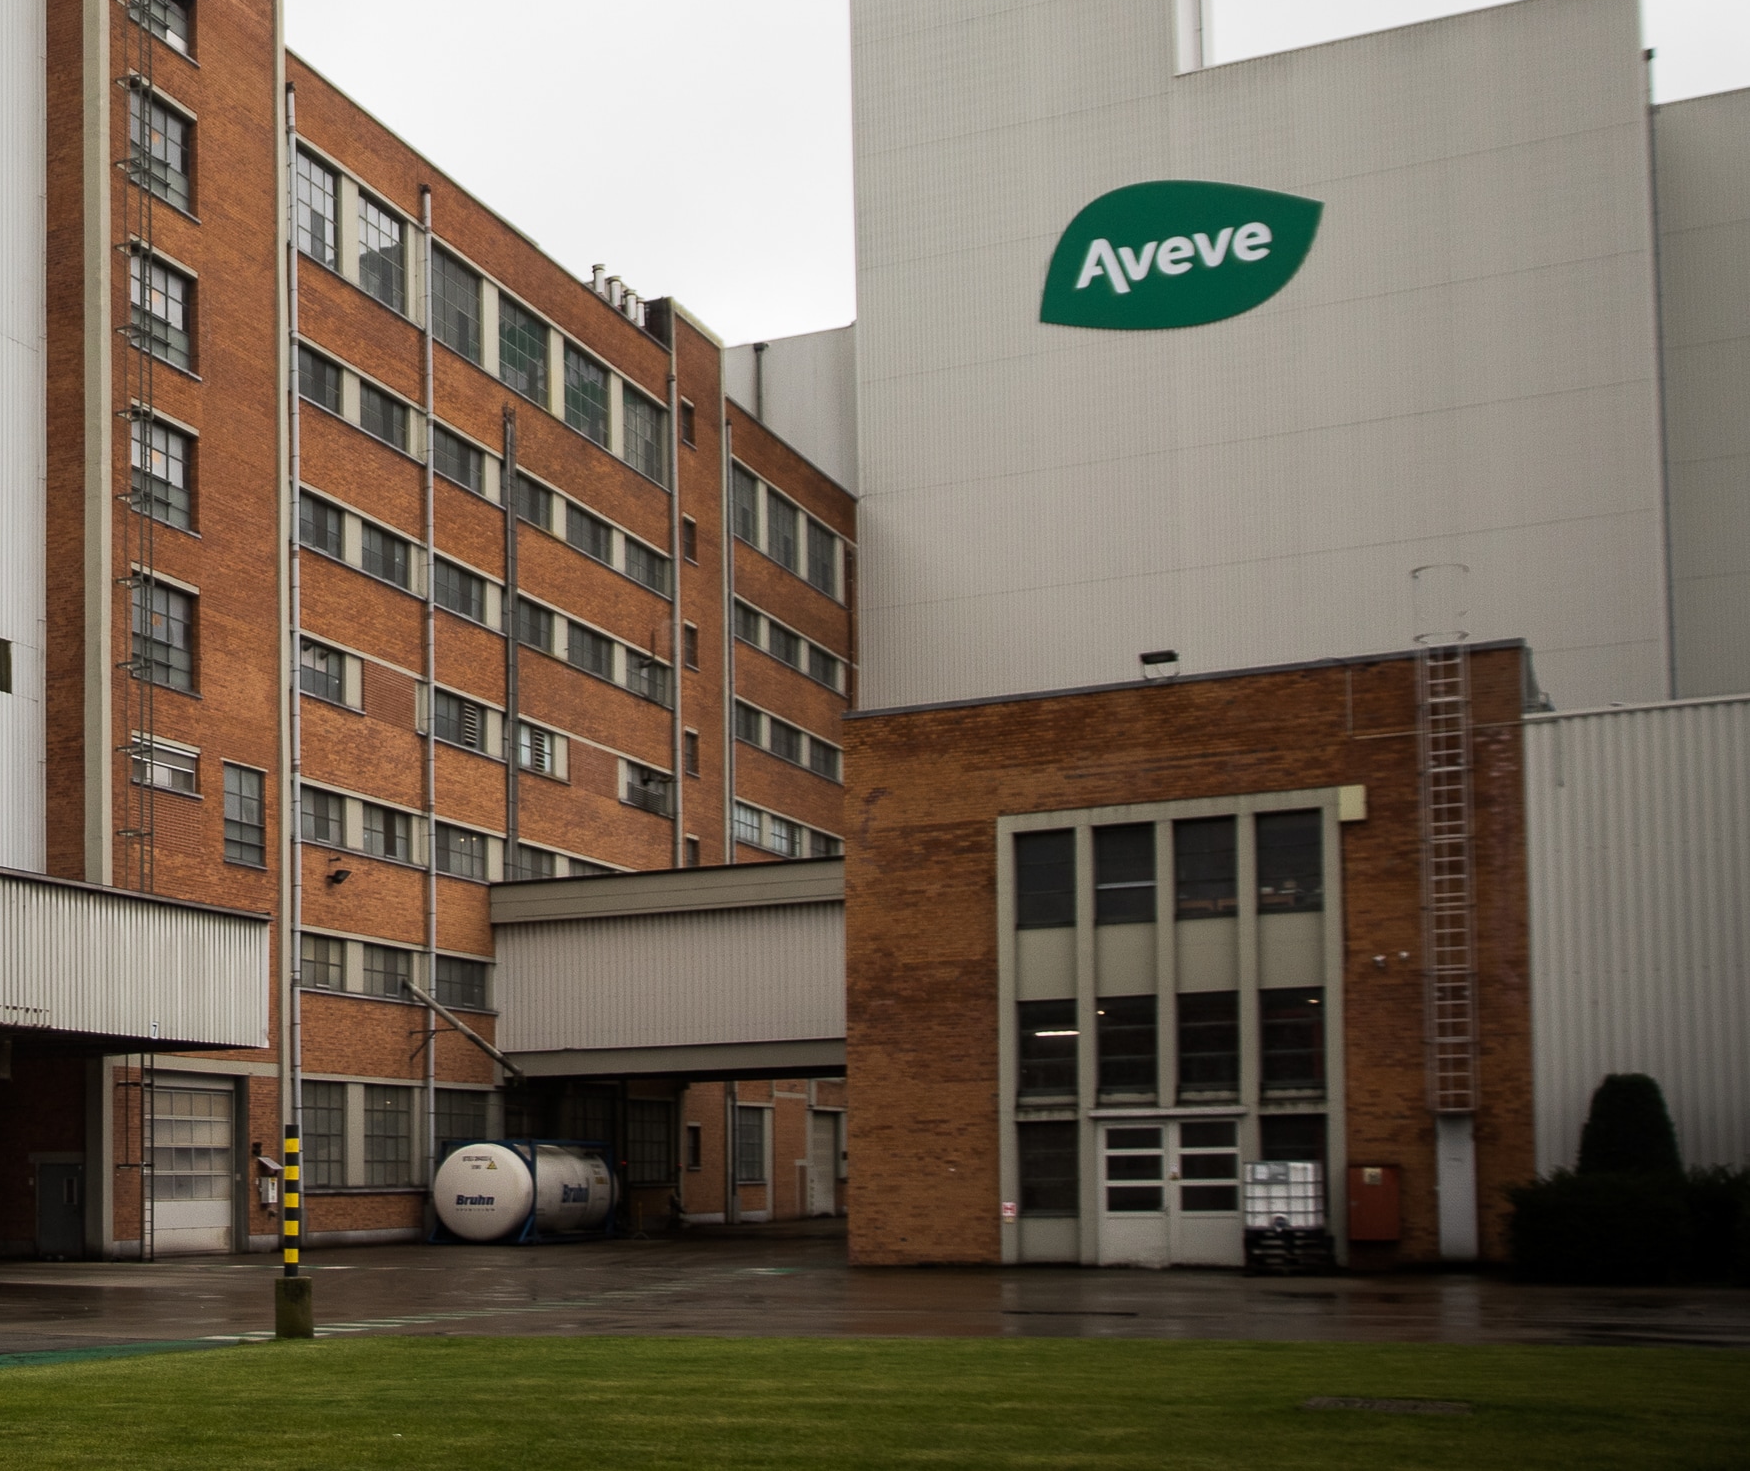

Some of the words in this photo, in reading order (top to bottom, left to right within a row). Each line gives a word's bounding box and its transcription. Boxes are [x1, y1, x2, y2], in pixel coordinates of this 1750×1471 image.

[1075, 222, 1273, 294] Aveve
[152, 1024, 158, 1037] 7
[456, 1194, 495, 1205] Bruhn
[562, 1183, 589, 1203] Bruhn
